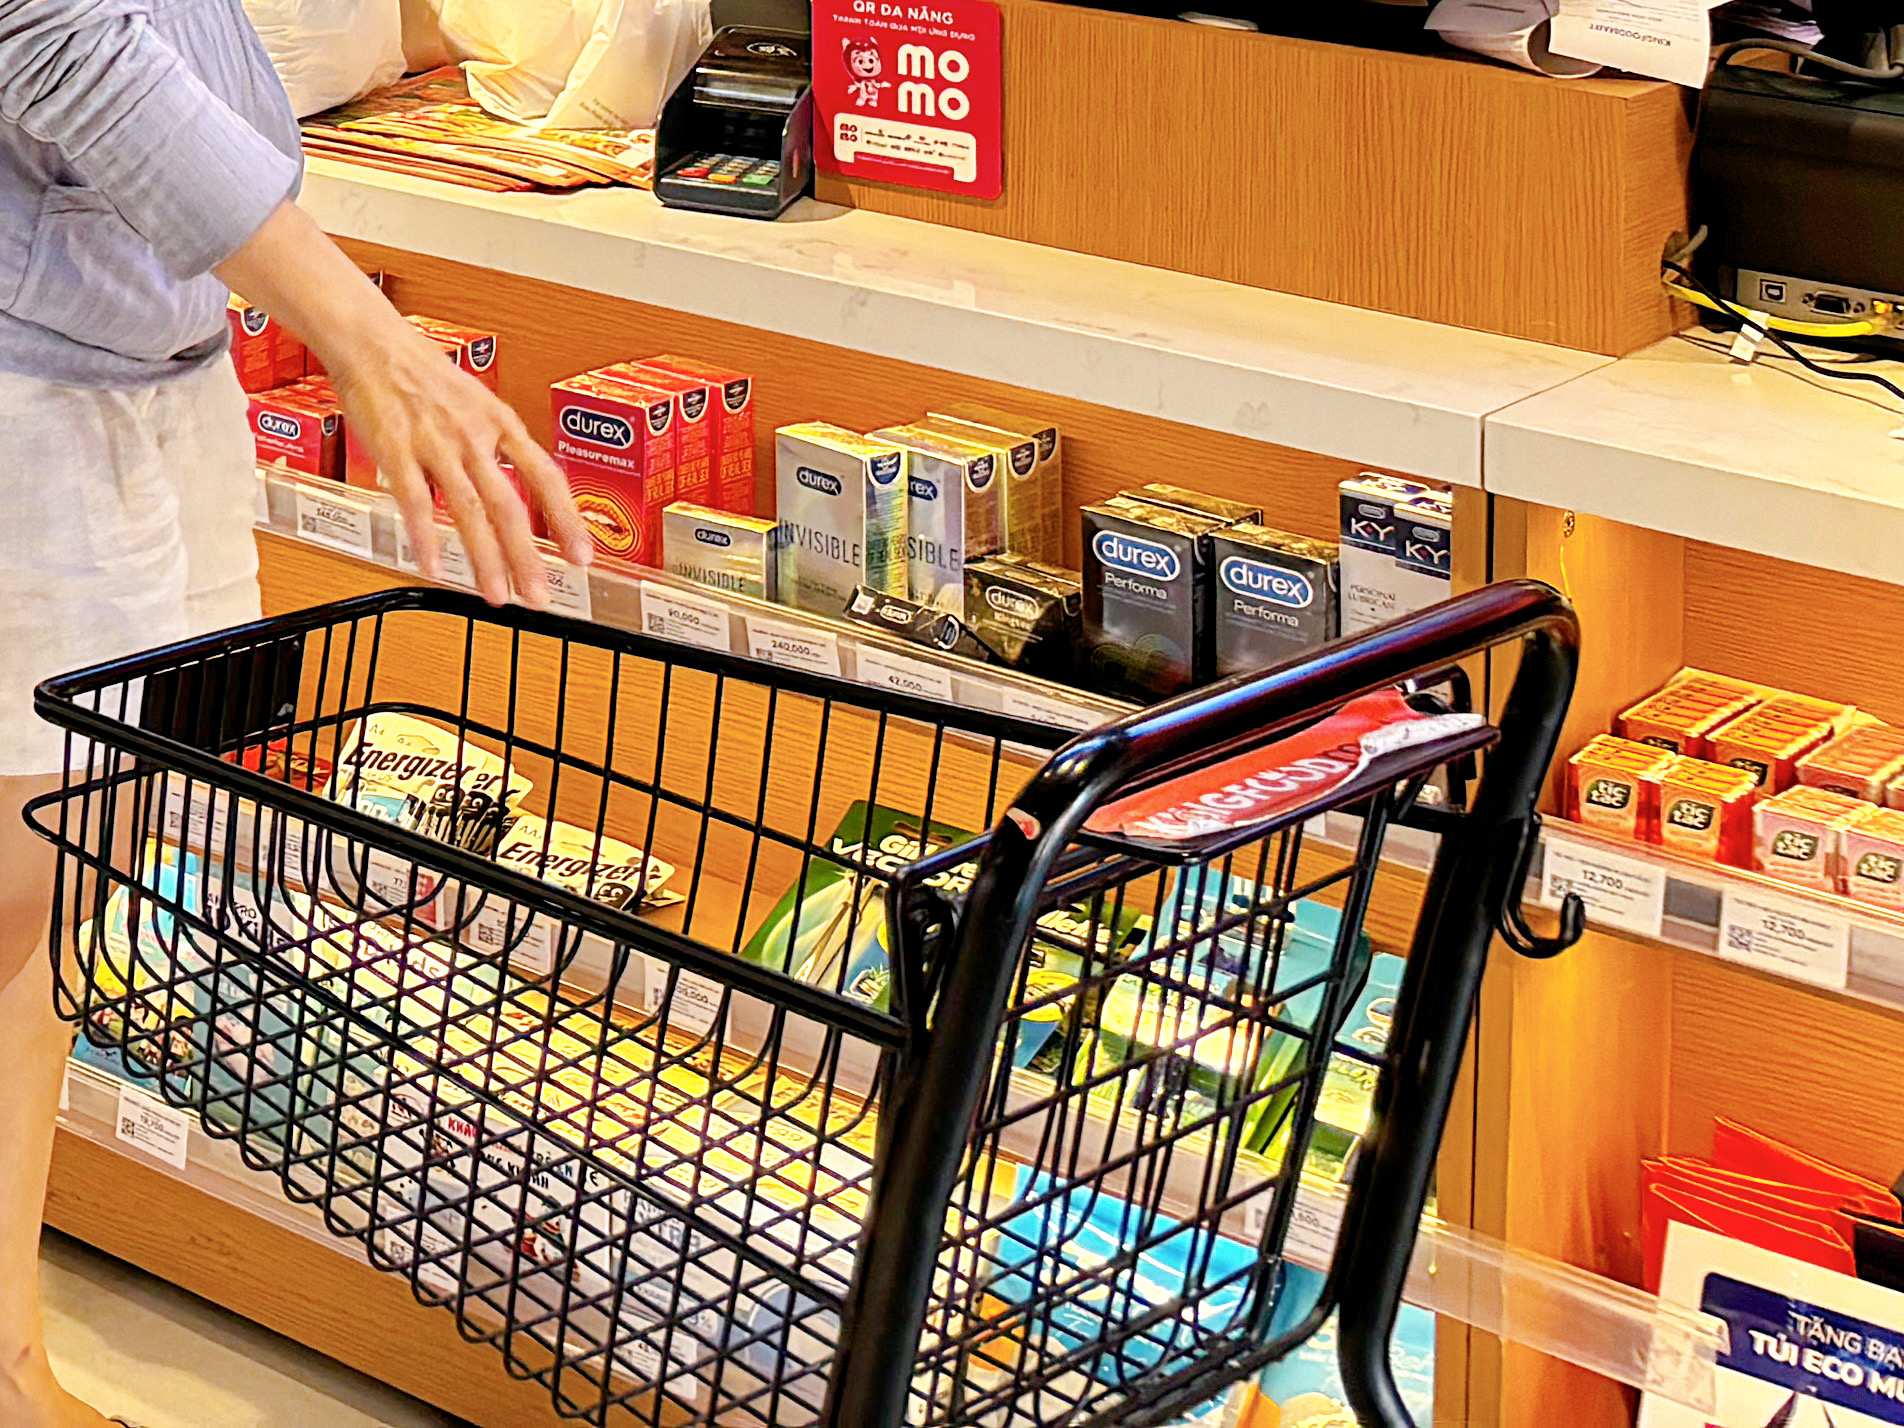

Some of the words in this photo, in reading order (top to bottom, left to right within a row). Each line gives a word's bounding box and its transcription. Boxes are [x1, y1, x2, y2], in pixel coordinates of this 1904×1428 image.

[853, 0, 875, 15] QR
[907, 6, 953, 24] NĂNG
[567, 413, 631, 440] durex
[558, 441, 634, 468] Pleasuremax
[799, 470, 841, 492] durex
[781, 517, 861, 567] INVISIBLE
[1101, 542, 1173, 575] durex
[1105, 572, 1167, 600] Performa
[1228, 566, 1304, 600] durex
[1235, 600, 1299, 626] Performa
[344, 743, 474, 789] Energizer
[499, 842, 640, 883] Energizer
[1582, 869, 1624, 890] 12,700
[1762, 917, 1805, 940] 12,700
[1803, 1348, 1864, 1386] ECO
